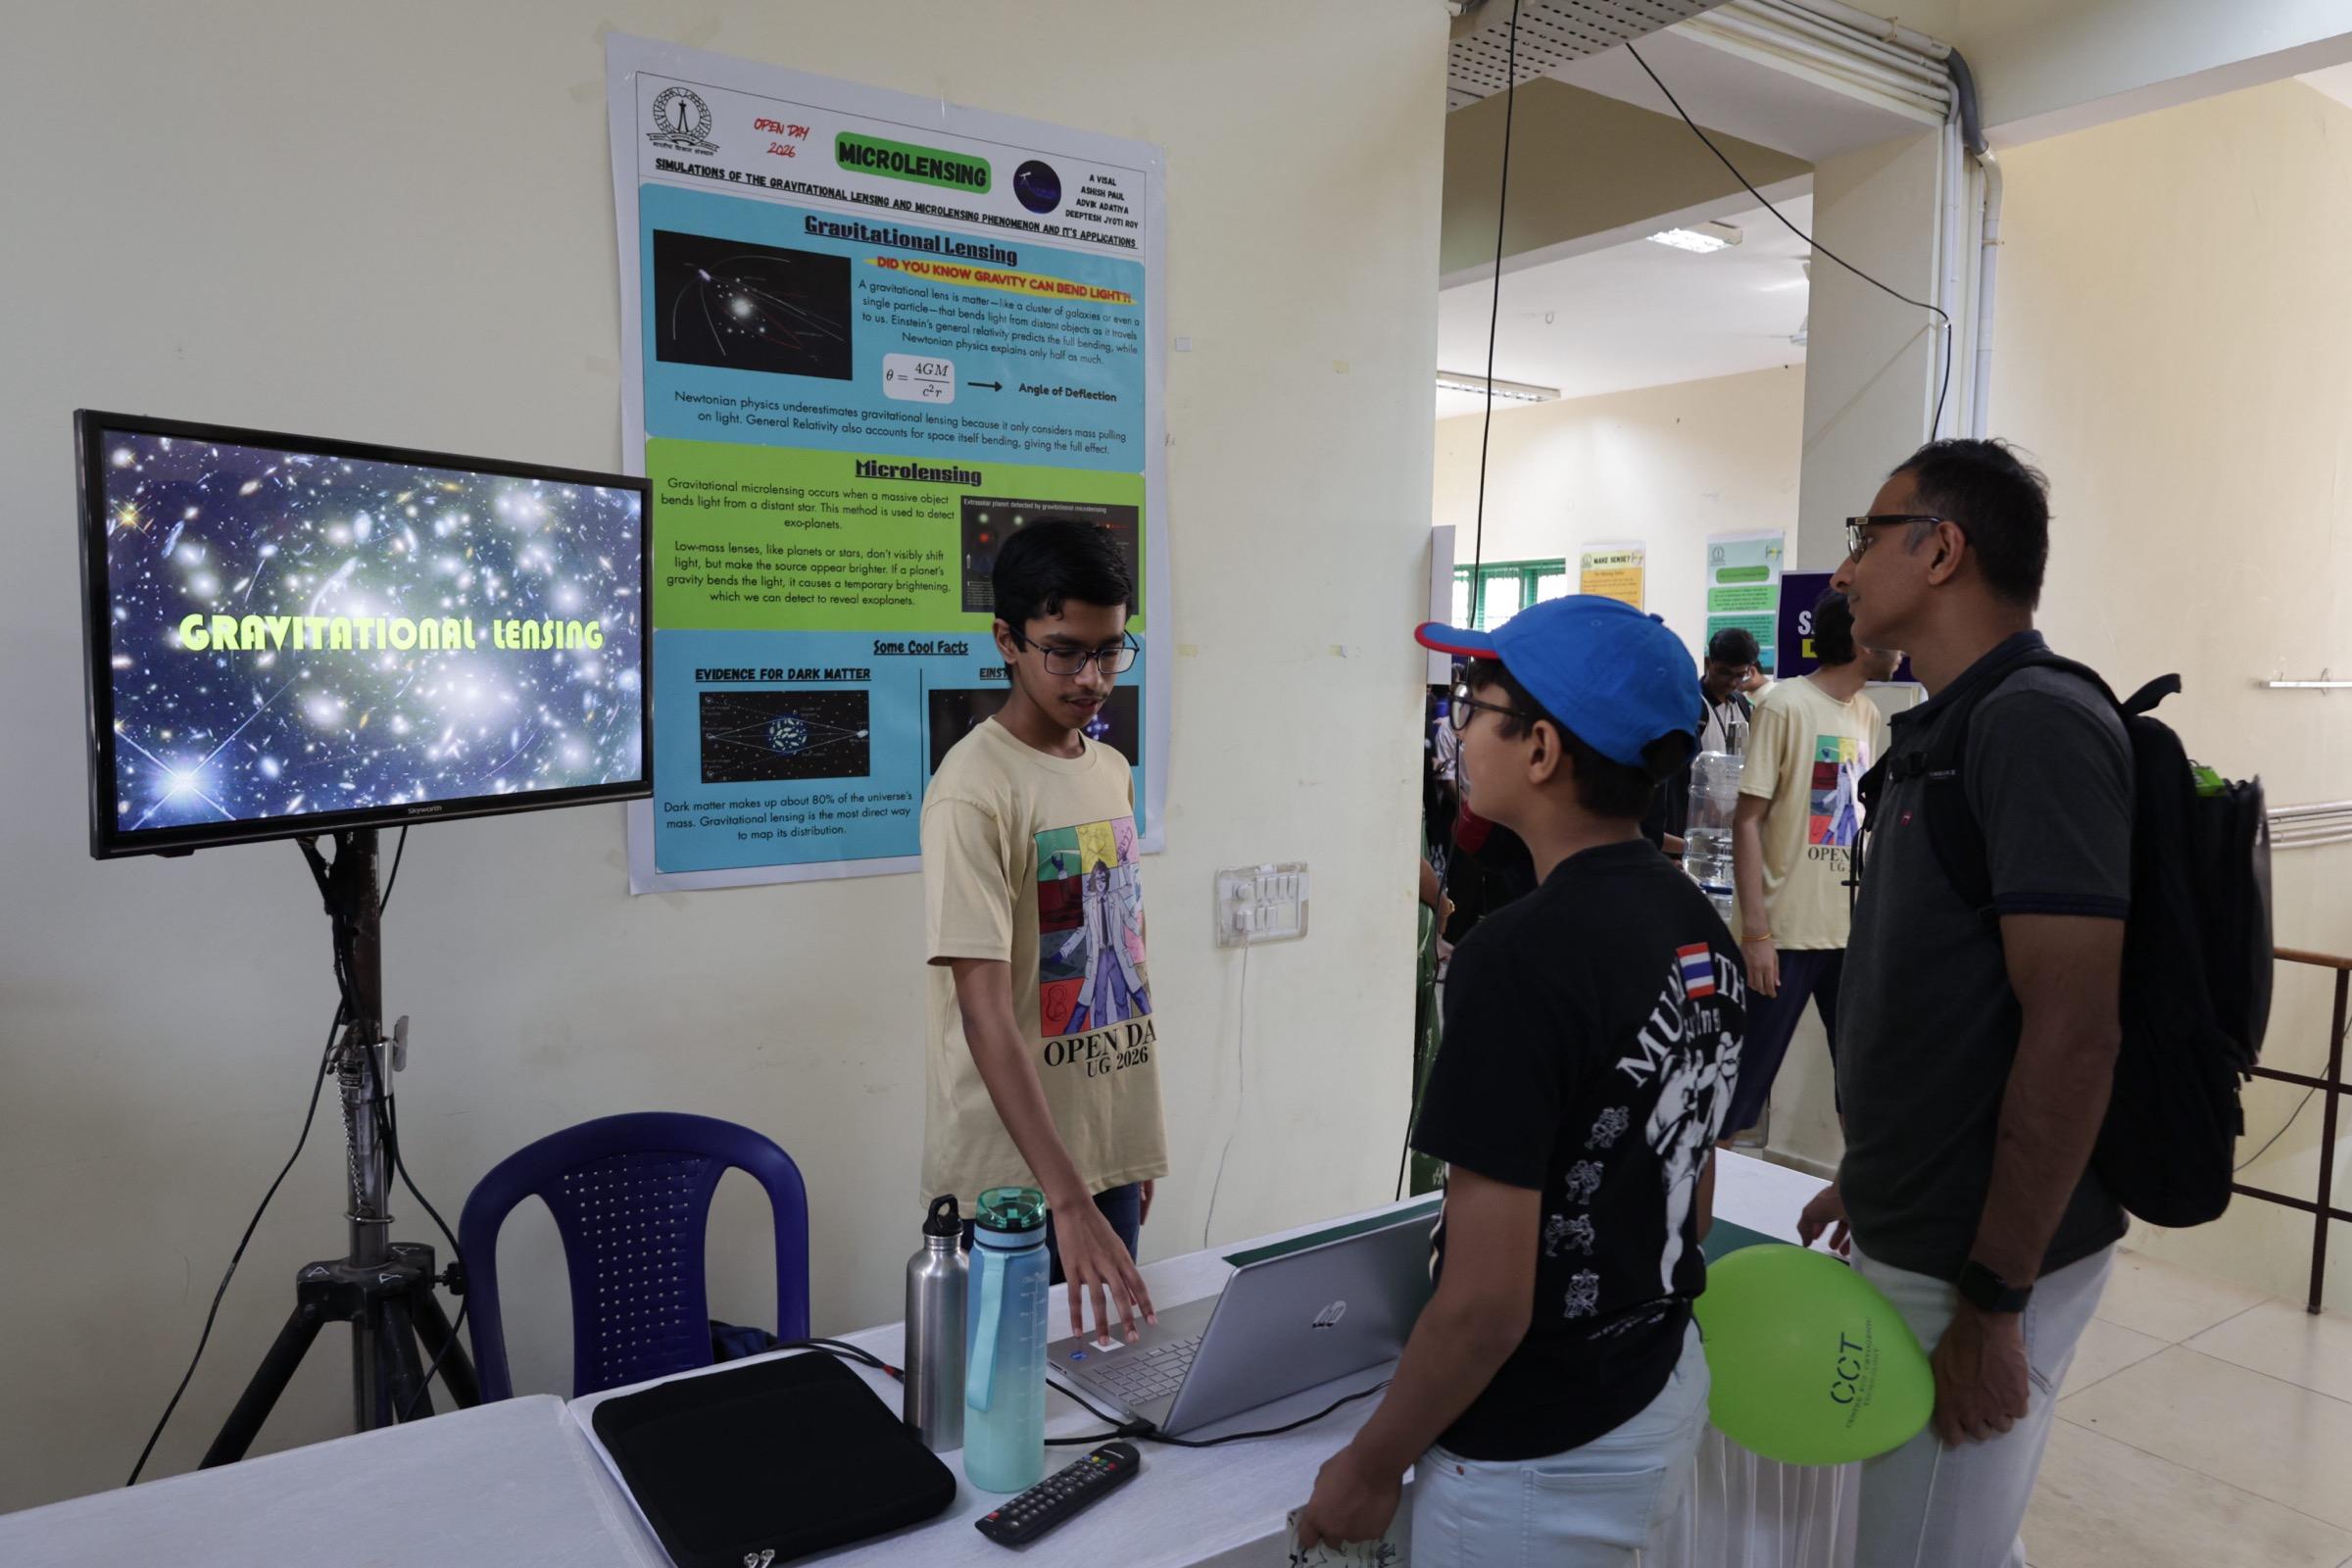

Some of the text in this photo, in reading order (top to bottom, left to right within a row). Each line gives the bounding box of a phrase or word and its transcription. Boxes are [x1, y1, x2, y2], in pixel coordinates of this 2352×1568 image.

[754, 118, 810, 141] OPEN DAY
[767, 142, 796, 158] 2026
[839, 140, 987, 188] MICROLENSING
[1088, 172, 1117, 187] A VISAL
[655, 157, 725, 180] SIMULATIONS
[727, 170, 742, 183] OF
[744, 172, 766, 187] THE
[769, 177, 848, 201] GRAVITATIONAL
[850, 190, 890, 209] LENSING
[892, 198, 912, 212] AND
[914, 202, 979, 223] MICROLENSING
[981, 213, 1040, 233] PHENOMENON
[1042, 223, 1060, 237] AND
[1079, 230, 1137, 249] APPLICATIONS
[1079, 184, 1125, 201] ASHISH PAUL
[804, 214, 1018, 268] Gravitational Lensing
[876, 255, 899, 270] DID
[901, 259, 930, 274] YOU
[932, 264, 971, 279] KNOW
[973, 270, 1027, 288] GRAVITY
[1028, 278, 1054, 292] CAN
[1055, 282, 1087, 296] BEND
[868, 282, 929, 298] gravitational
[1024, 301, 1053, 315] cluster
[1064, 307, 1101, 321] galaxies
[861, 296, 891, 311] single
[956, 306, 986, 321] bends
[1030, 316, 1059, 330] distant
[1060, 320, 1091, 335] objects
[1111, 328, 1138, 341] travels
[901, 330, 1027, 356] Newtonian physics explains
[934, 321, 970, 334] general
[971, 323, 1010, 341] relativity
[1010, 330, 1046, 343] predicts
[1017, 381, 1117, 402] Angle of Deflection
[673, 389, 1127, 444] Newtonian physics underestimates gravitational lensing because considers pulling
[714, 411, 1109, 455] light. General Relativity accounts space bending, giving effect.
[855, 459, 982, 487] Microlensing
[666, 476, 949, 507] Gravitational microlensing occurs when massive object
[660, 492, 955, 520] bends light from distant method detect
[674, 539, 923, 564] Low-mass lenses, planets visibly
[673, 556, 702, 571] light,
[723, 557, 754, 570] make
[808, 564, 847, 575] appear
[848, 562, 888, 576] brighter.
[665, 573, 704, 588] gravity
[706, 573, 739, 586] bends
[760, 574, 786, 590] light,
[843, 578, 894, 593] temporary
[895, 578, 951, 594] brightening,
[709, 589, 915, 608] which detect reveal exoplanets.
[178, 613, 604, 652] GRAVITATIONAL LENSING
[872, 638, 968, 654] Some Cool Facts
[694, 667, 870, 679] EVIDENCE FOR DARK MATTER
[662, 791, 912, 813] Dark matter makes about universe's
[698, 806, 888, 827] Gravitational lensing direct
[789, 823, 847, 838] distribution.
[1807, 846, 1850, 861] OPEN
[1043, 1019, 1157, 1067] OPEN DA
[1086, 1047, 1149, 1078] UG 2026
[1830, 1331, 1863, 1404] CCT
